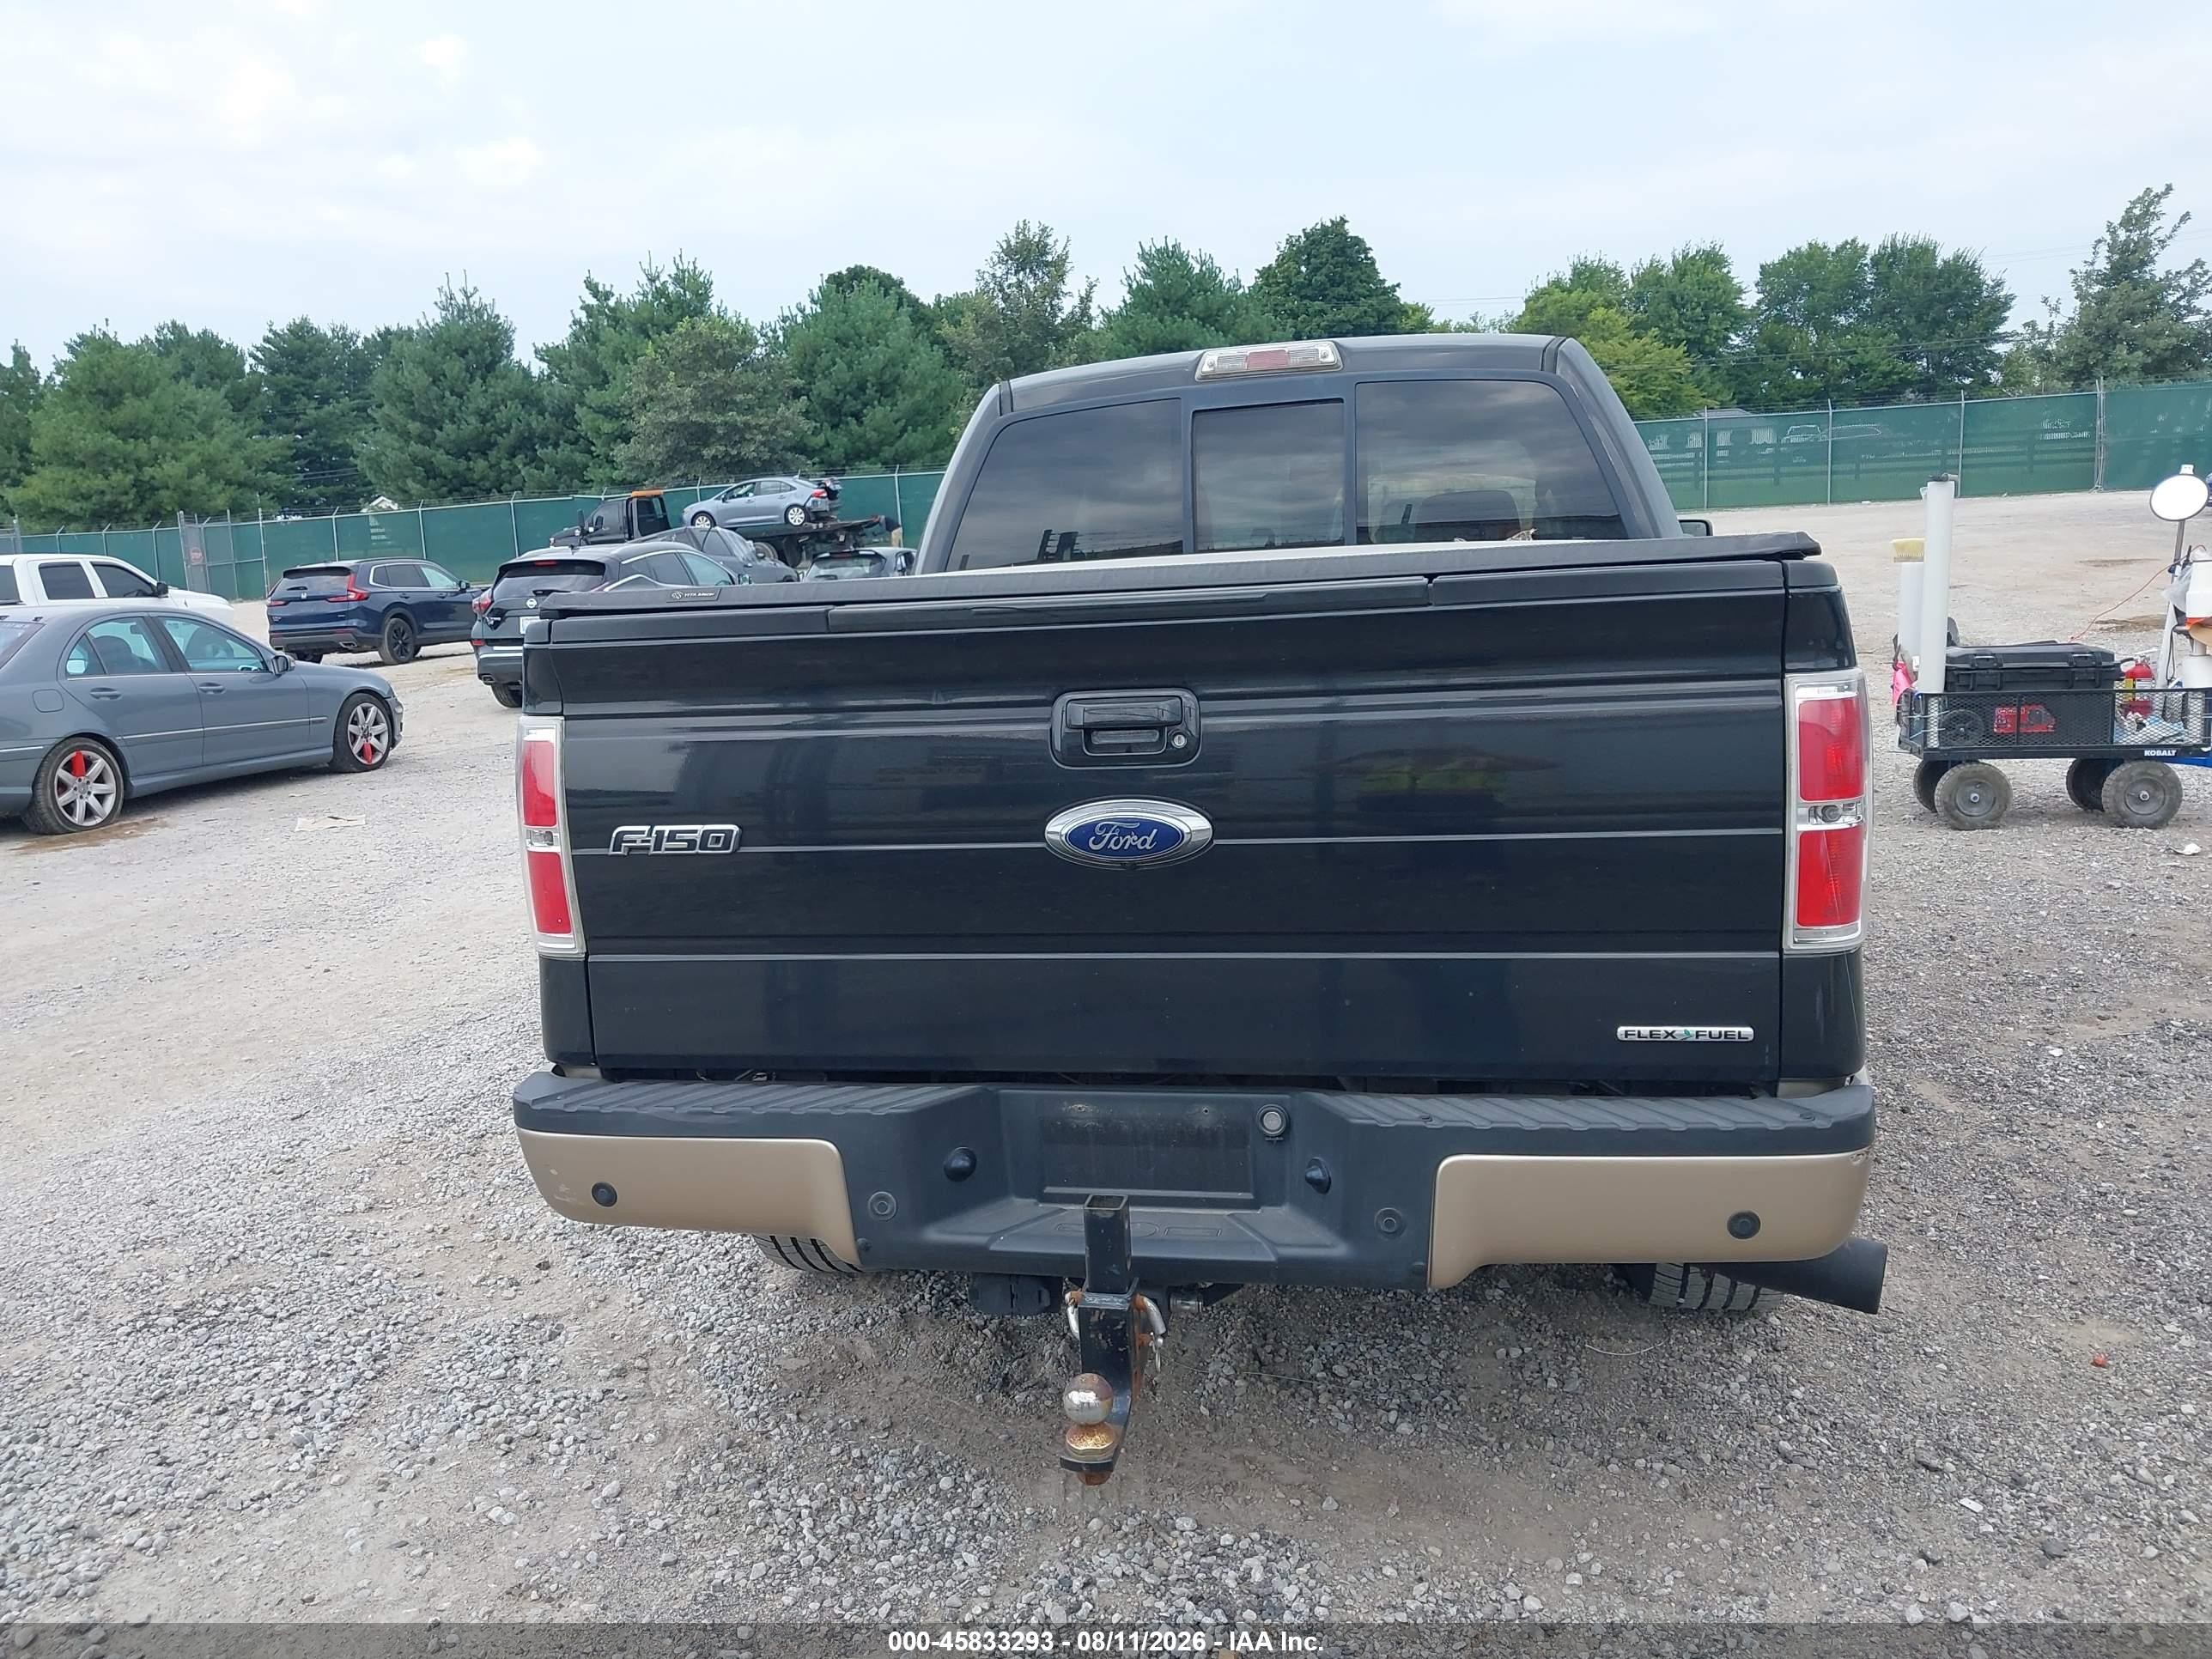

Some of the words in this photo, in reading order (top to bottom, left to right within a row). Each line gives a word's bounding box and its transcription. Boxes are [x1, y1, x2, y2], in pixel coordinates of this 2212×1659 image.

[608, 824, 743, 855] F-150
[1088, 821, 1158, 850] Ford
[1624, 1030, 1677, 1039] FLEX
[1695, 1030, 1749, 1040] FUEL
